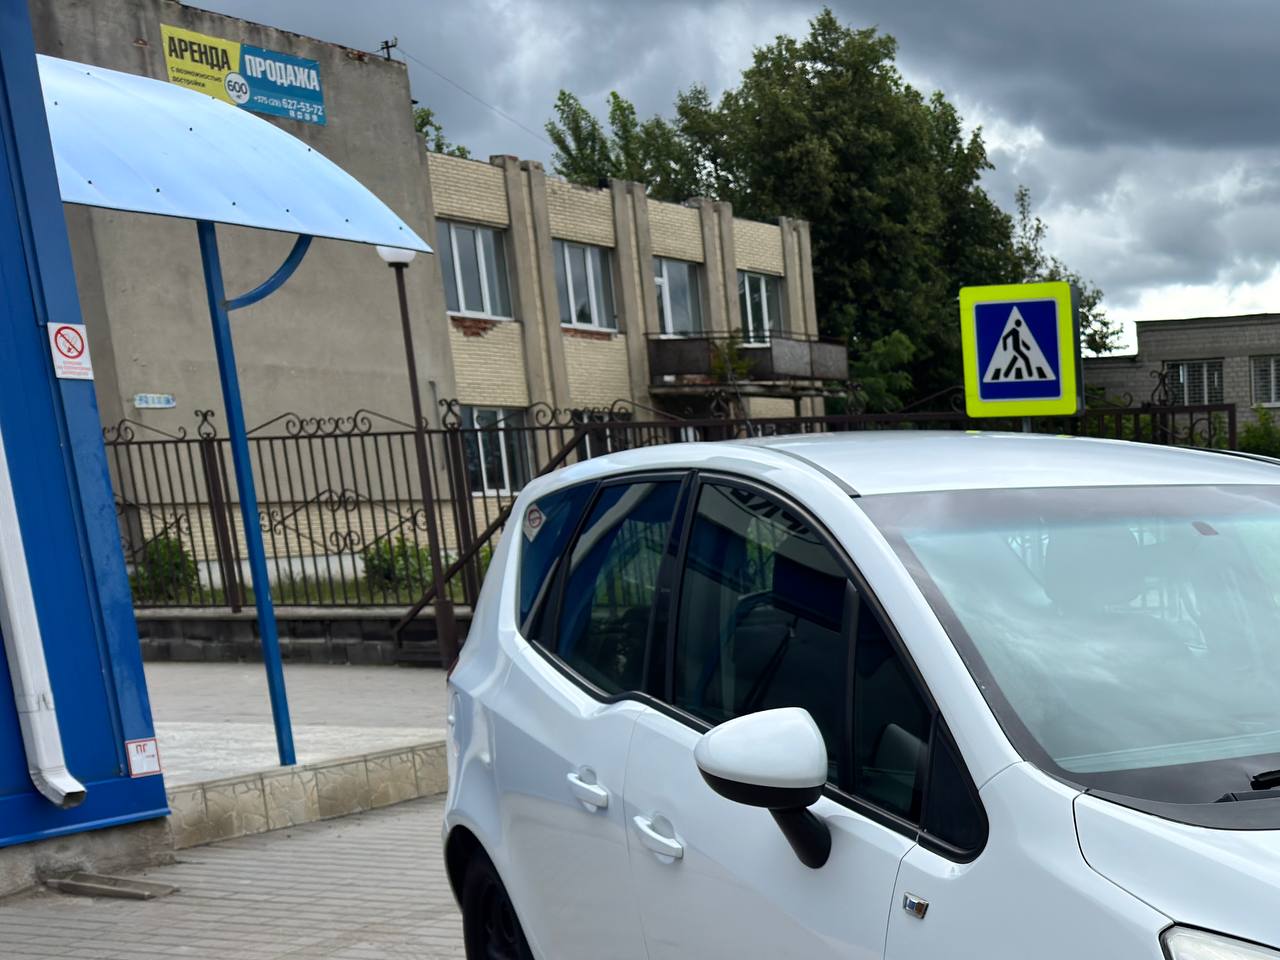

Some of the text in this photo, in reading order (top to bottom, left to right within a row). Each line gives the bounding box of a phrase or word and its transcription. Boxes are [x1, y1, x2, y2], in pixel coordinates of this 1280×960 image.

[168, 36, 232, 71] АРЕНДА
[226, 80, 248, 95] 600
[244, 54, 320, 92] ПРОДАЖА
